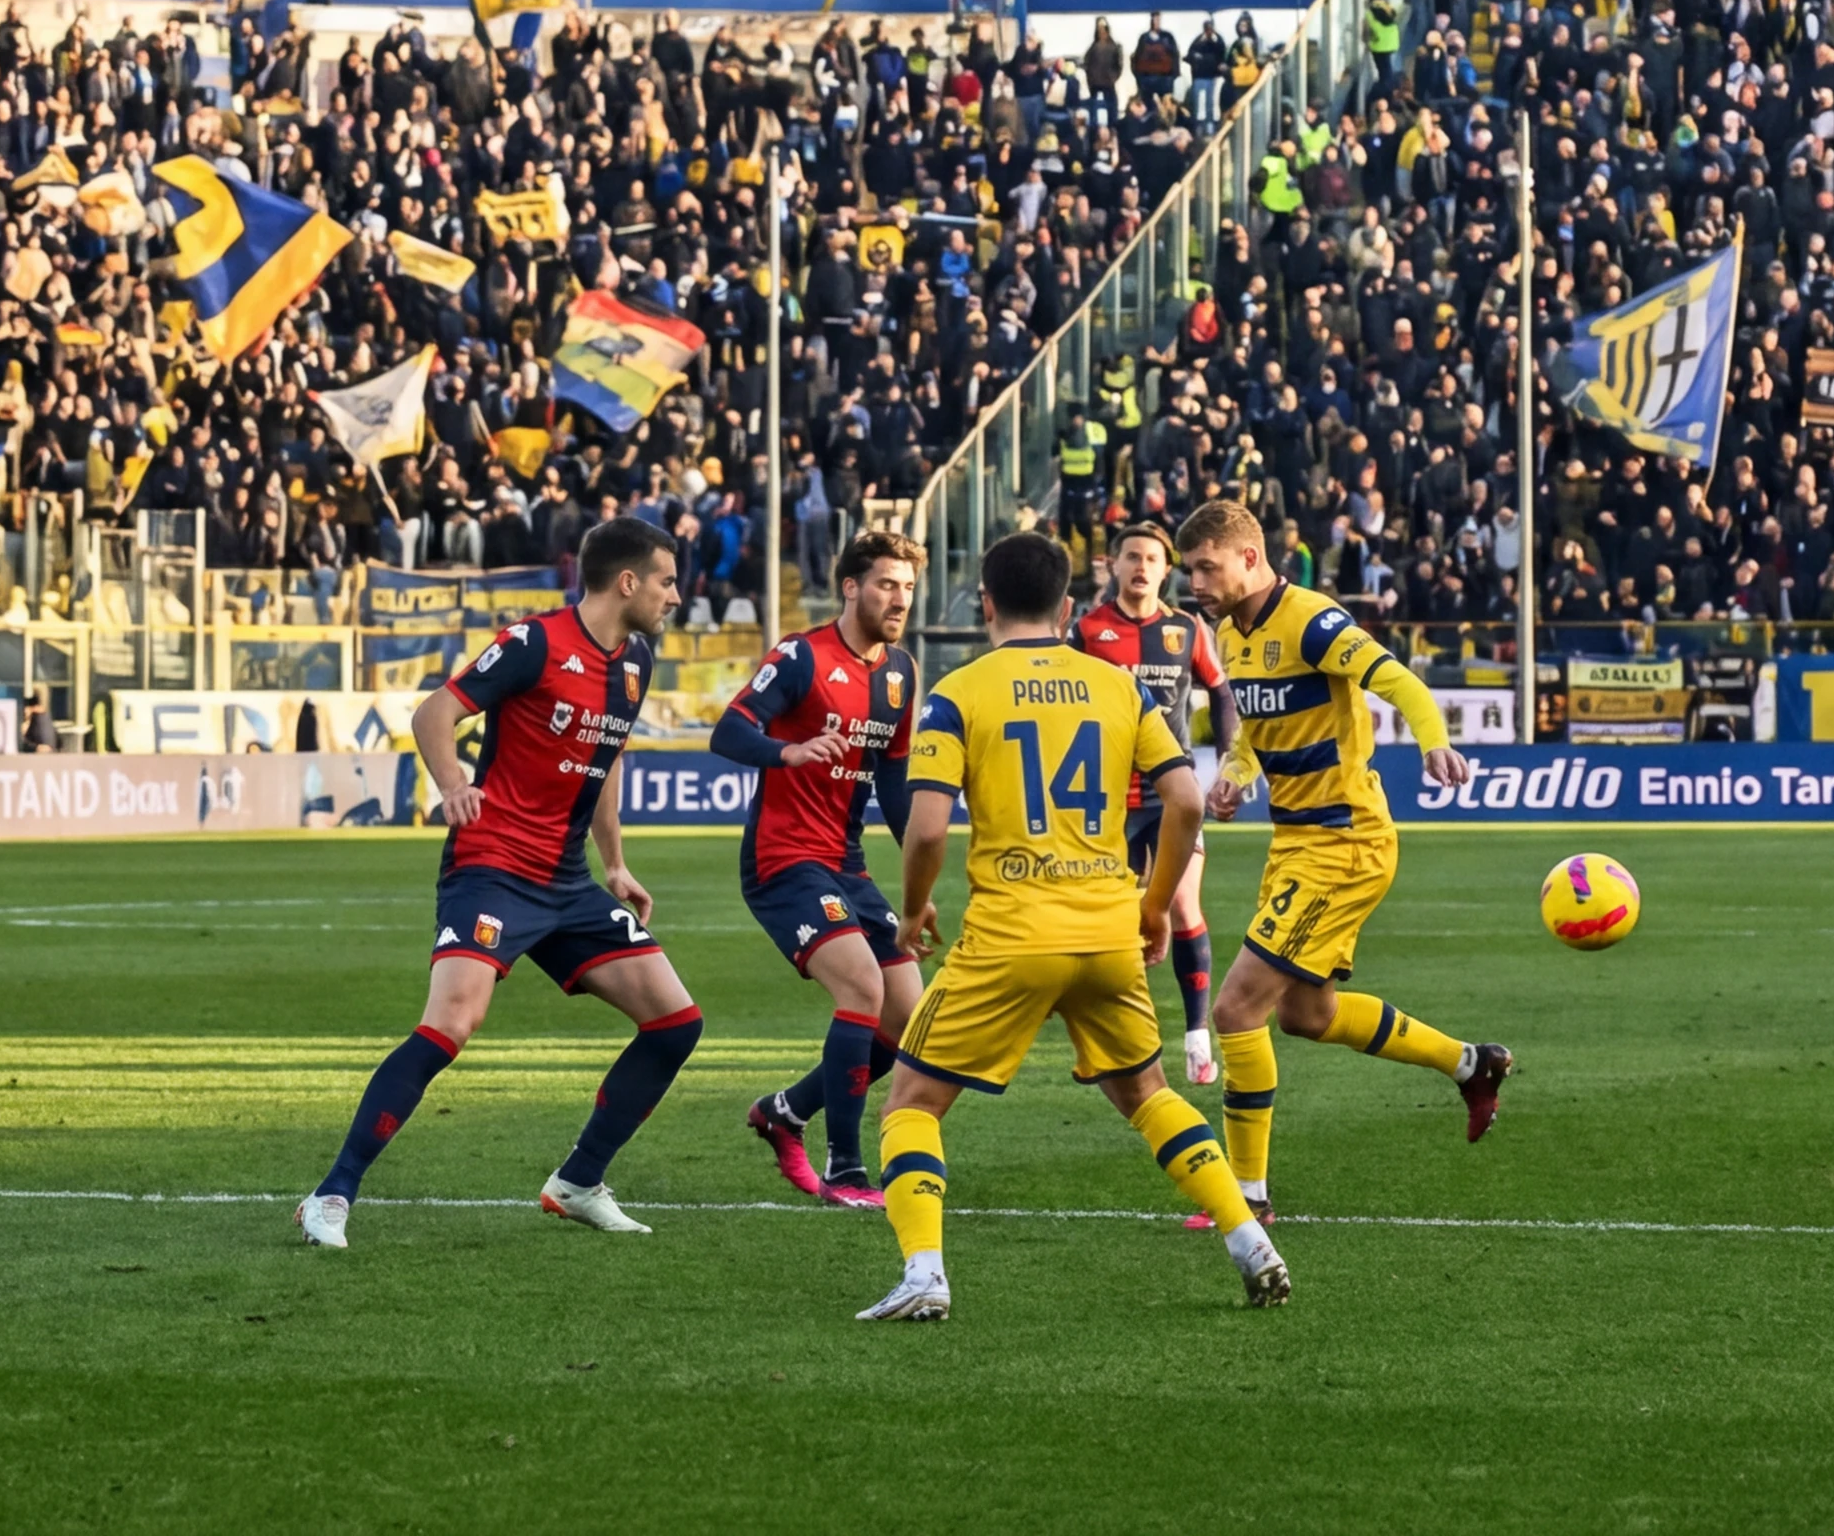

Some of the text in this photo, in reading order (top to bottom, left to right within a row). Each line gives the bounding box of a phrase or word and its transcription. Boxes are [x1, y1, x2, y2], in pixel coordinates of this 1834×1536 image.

[1003, 719, 1108, 837] 14
[1417, 756, 1623, 810] Stadio
[1639, 766, 1762, 806] Ennio
[609, 908, 651, 943] 2
